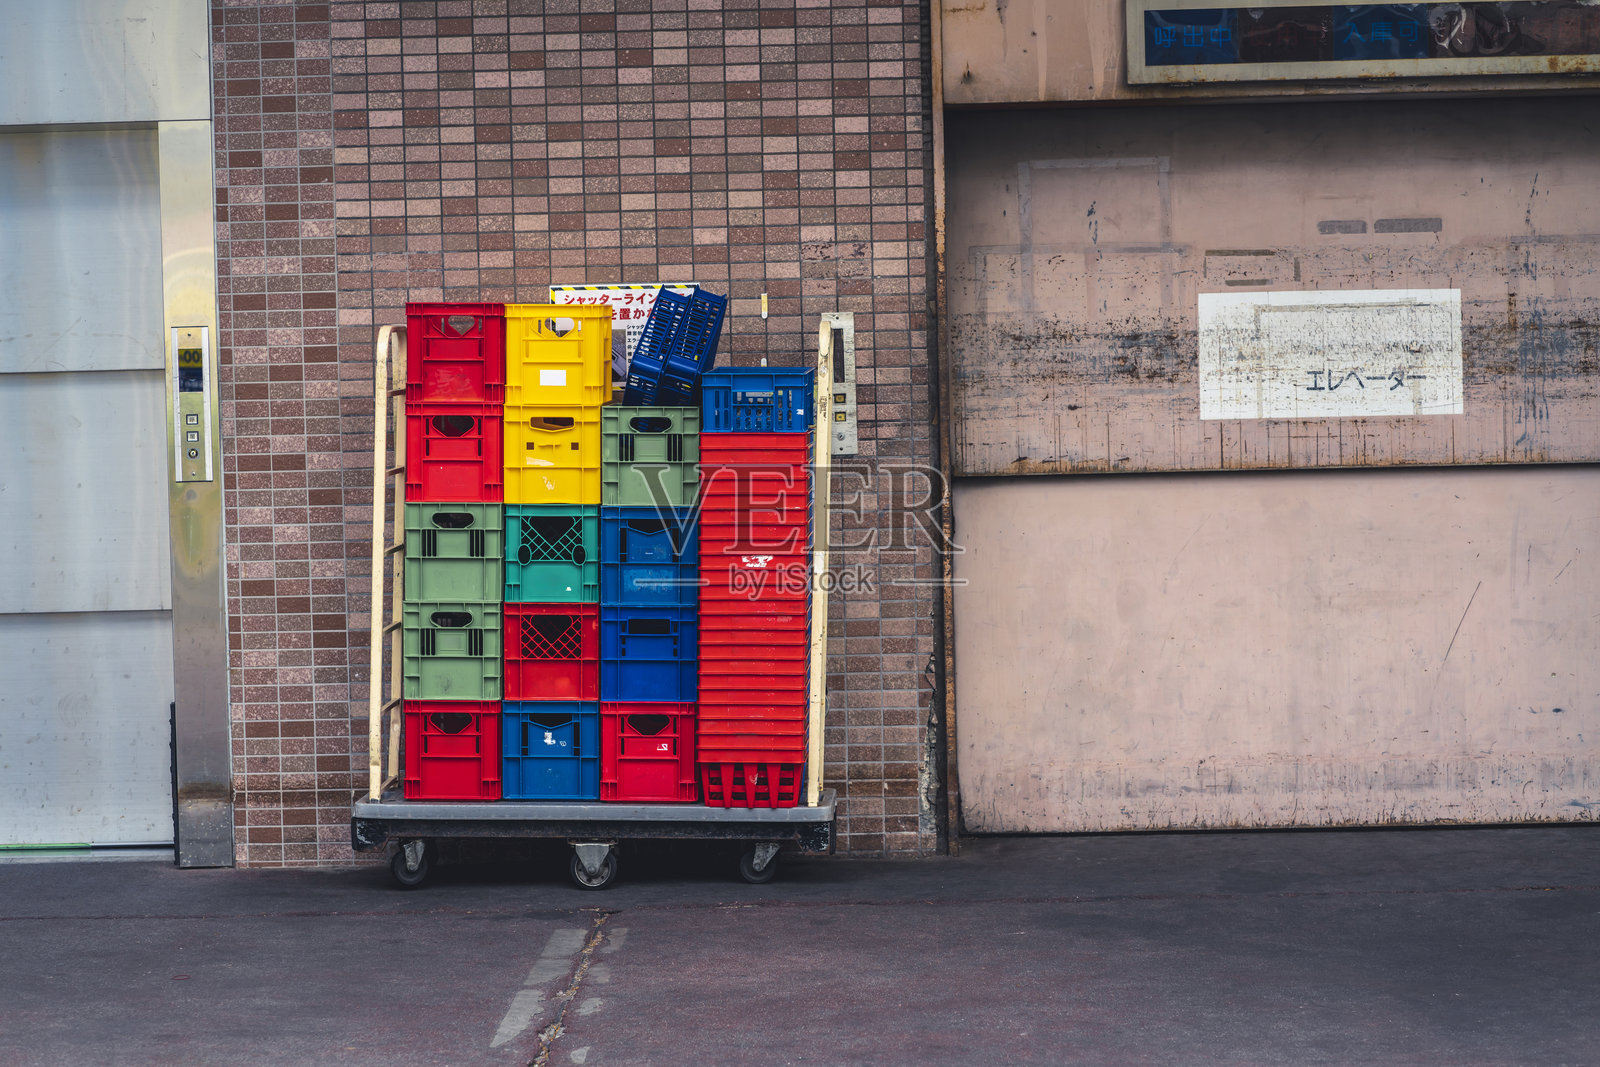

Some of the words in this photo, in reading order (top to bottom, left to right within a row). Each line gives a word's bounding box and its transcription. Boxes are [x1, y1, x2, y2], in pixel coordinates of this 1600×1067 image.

[1154, 24, 1231, 48] 呼出中
[1343, 20, 1420, 44] 入庫可
[564, 292, 686, 306] シャッターライン
